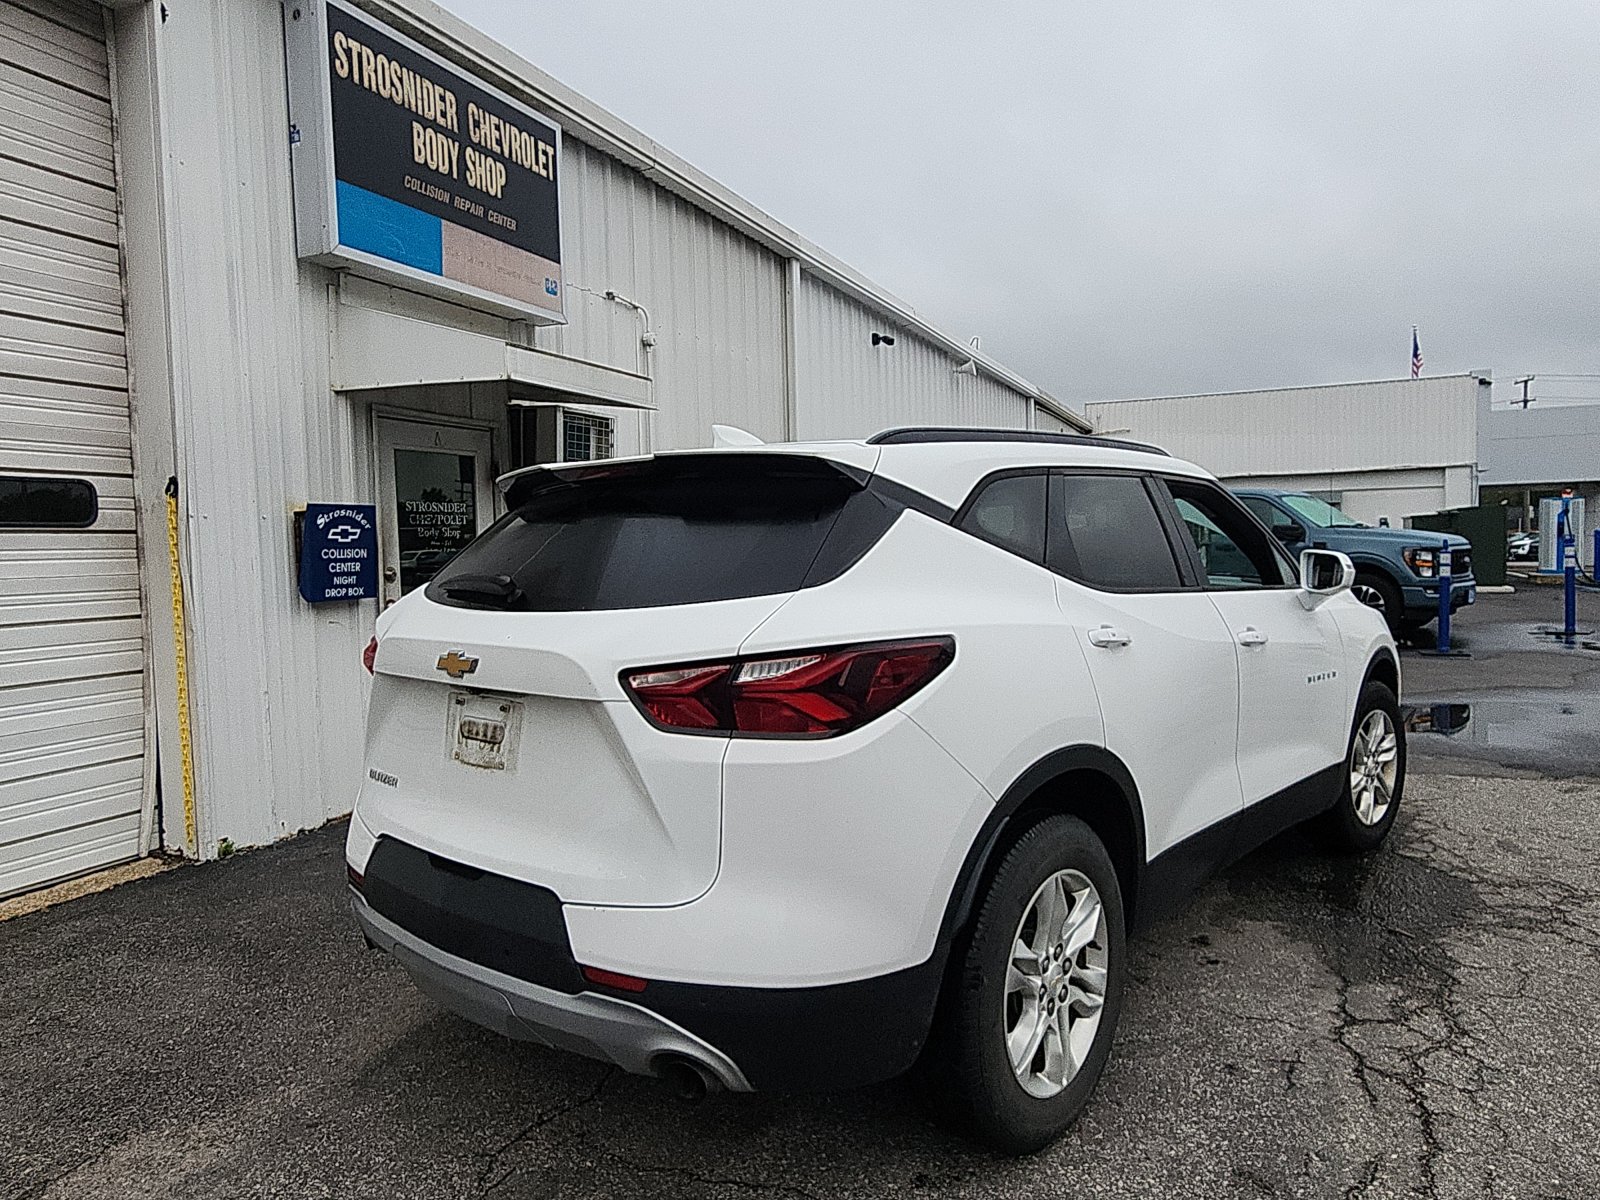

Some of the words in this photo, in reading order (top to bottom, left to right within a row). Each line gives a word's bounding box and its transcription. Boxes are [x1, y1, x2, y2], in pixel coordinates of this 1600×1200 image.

[333, 31, 459, 134] STROSNIDER
[467, 102, 554, 181] CHEVROLET
[412, 120, 460, 179] BODY
[465, 146, 507, 199] SHOP
[404, 175, 450, 204] COLLISION
[454, 196, 484, 218] REPAIR
[487, 209, 517, 231] CENTER
[405, 501, 467, 513] STROSNIDER
[316, 509, 371, 529] Strosnider
[417, 526, 440, 540] Body
[321, 548, 368, 559] COLLISION
[328, 562, 361, 573] CENTER
[333, 576, 357, 585] NIGHT
[325, 588, 347, 598] DROP
[348, 587, 365, 596] BOX
